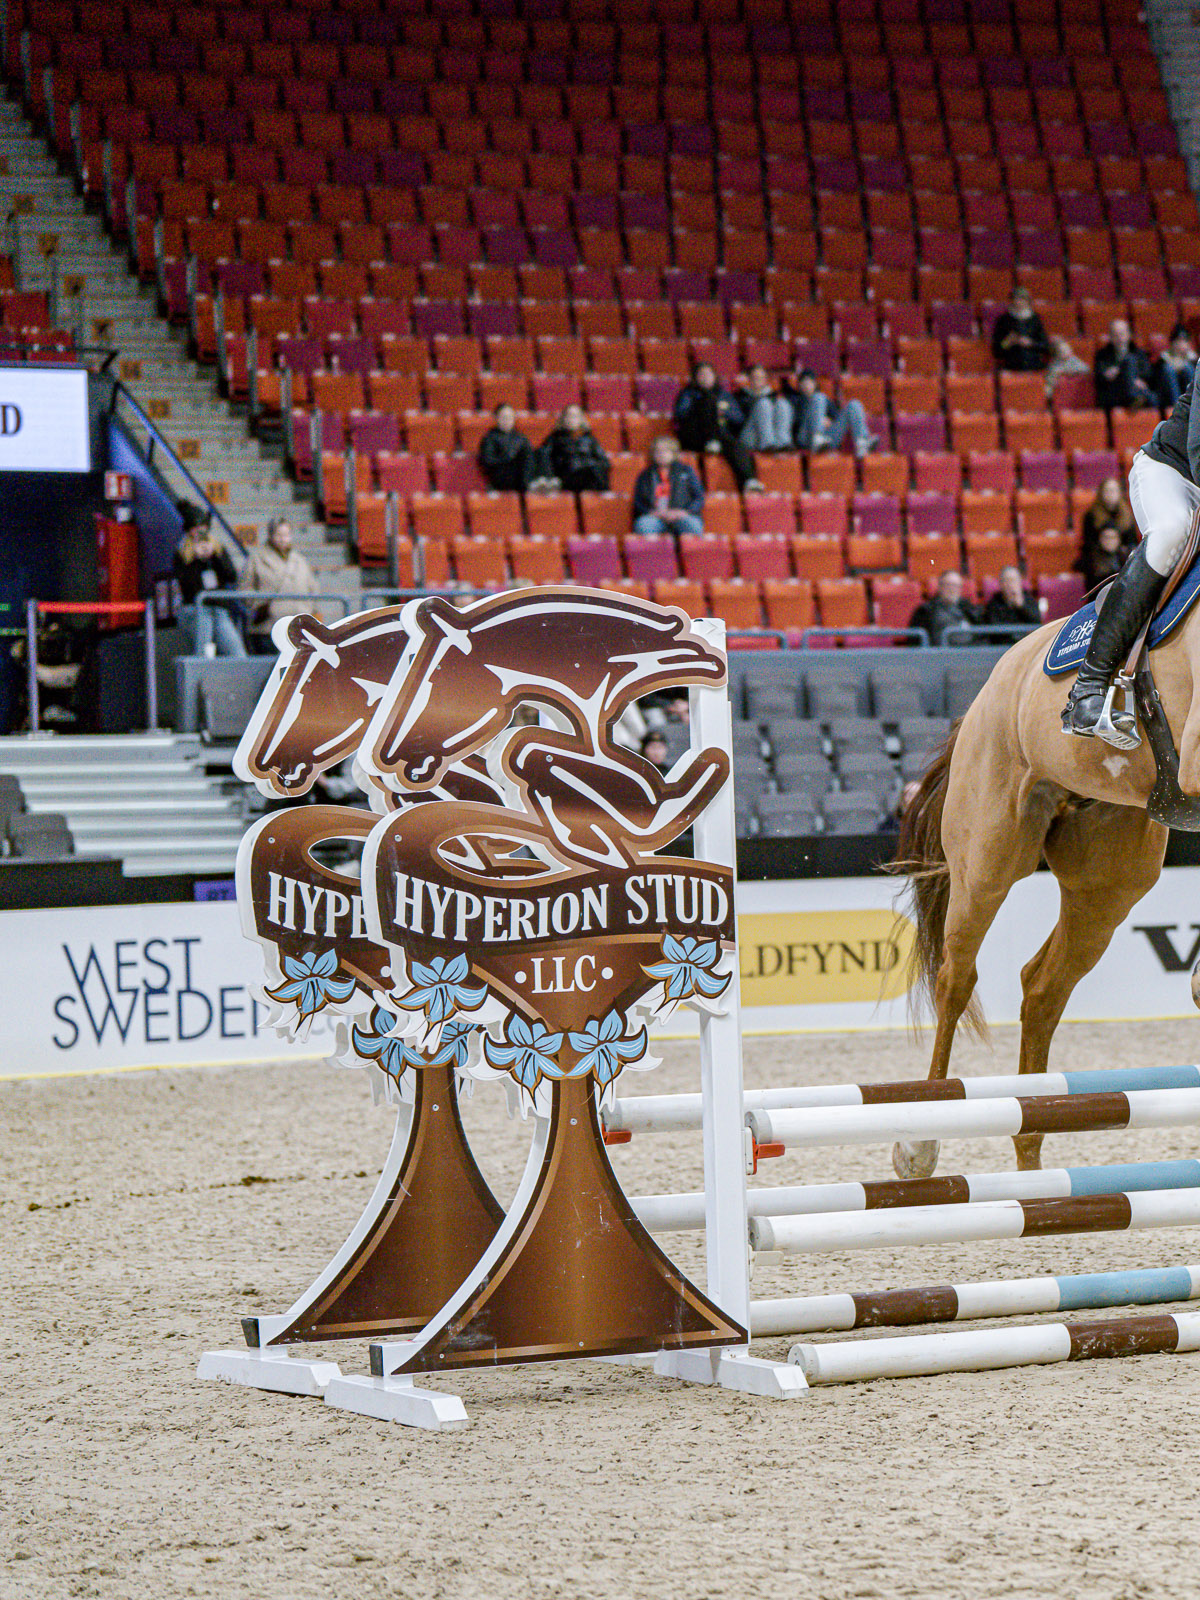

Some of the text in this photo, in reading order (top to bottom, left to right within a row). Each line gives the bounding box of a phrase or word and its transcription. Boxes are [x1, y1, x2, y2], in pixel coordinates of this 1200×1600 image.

[393, 871, 729, 942] HYPERION STUD
[62, 937, 201, 995] WEST
[530, 955, 598, 994] LLC
